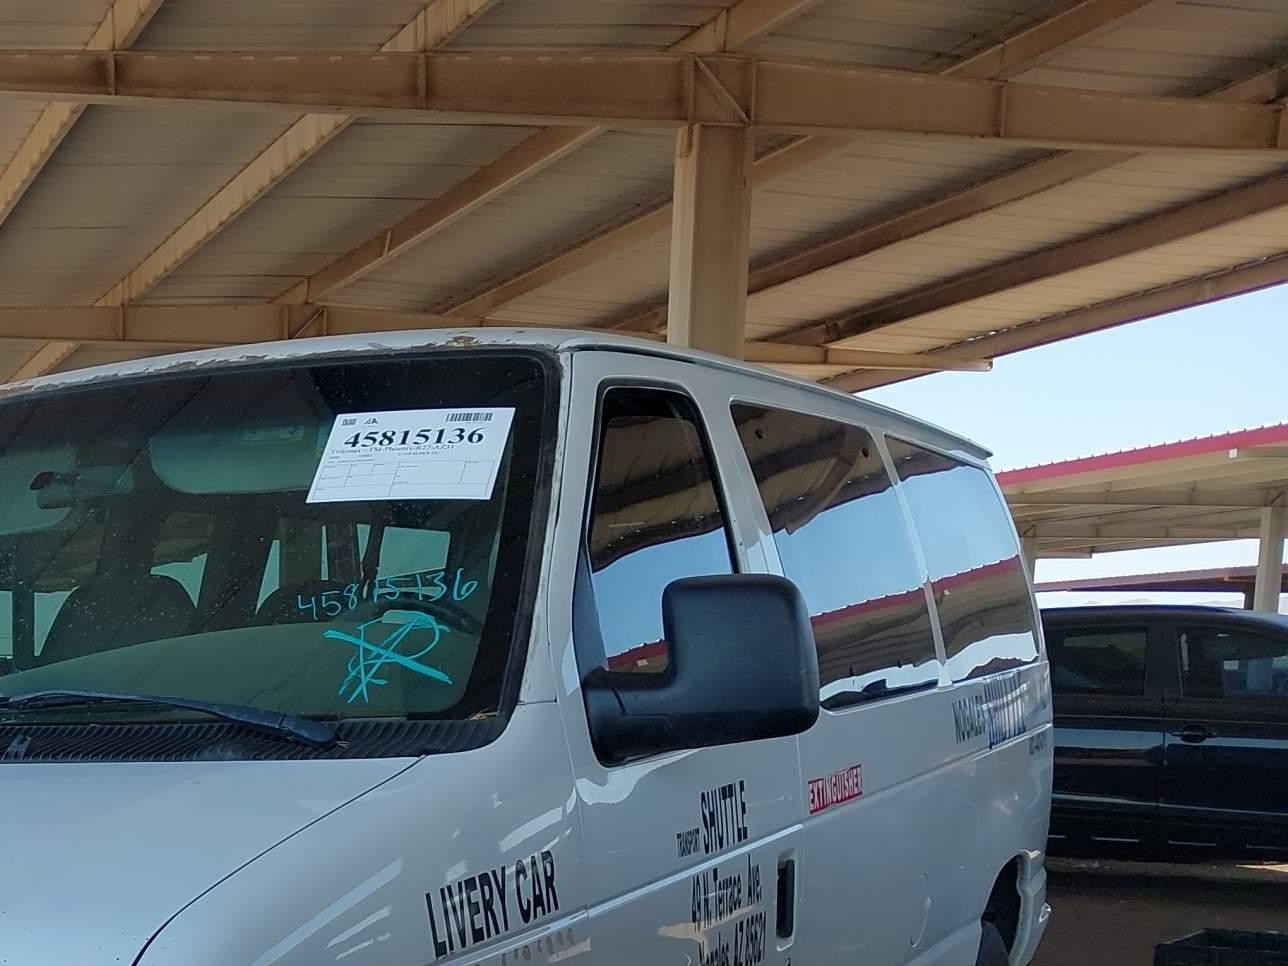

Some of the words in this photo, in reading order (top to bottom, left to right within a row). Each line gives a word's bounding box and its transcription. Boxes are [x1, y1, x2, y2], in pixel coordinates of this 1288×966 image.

[344, 427, 486, 448] 45815136
[808, 766, 862, 811] EXTINGUISHER
[700, 779, 748, 855] SHUTTLE
[424, 864, 510, 960] LIVERY
[514, 849, 560, 924] CAR
[713, 867, 742, 921] Terrace
